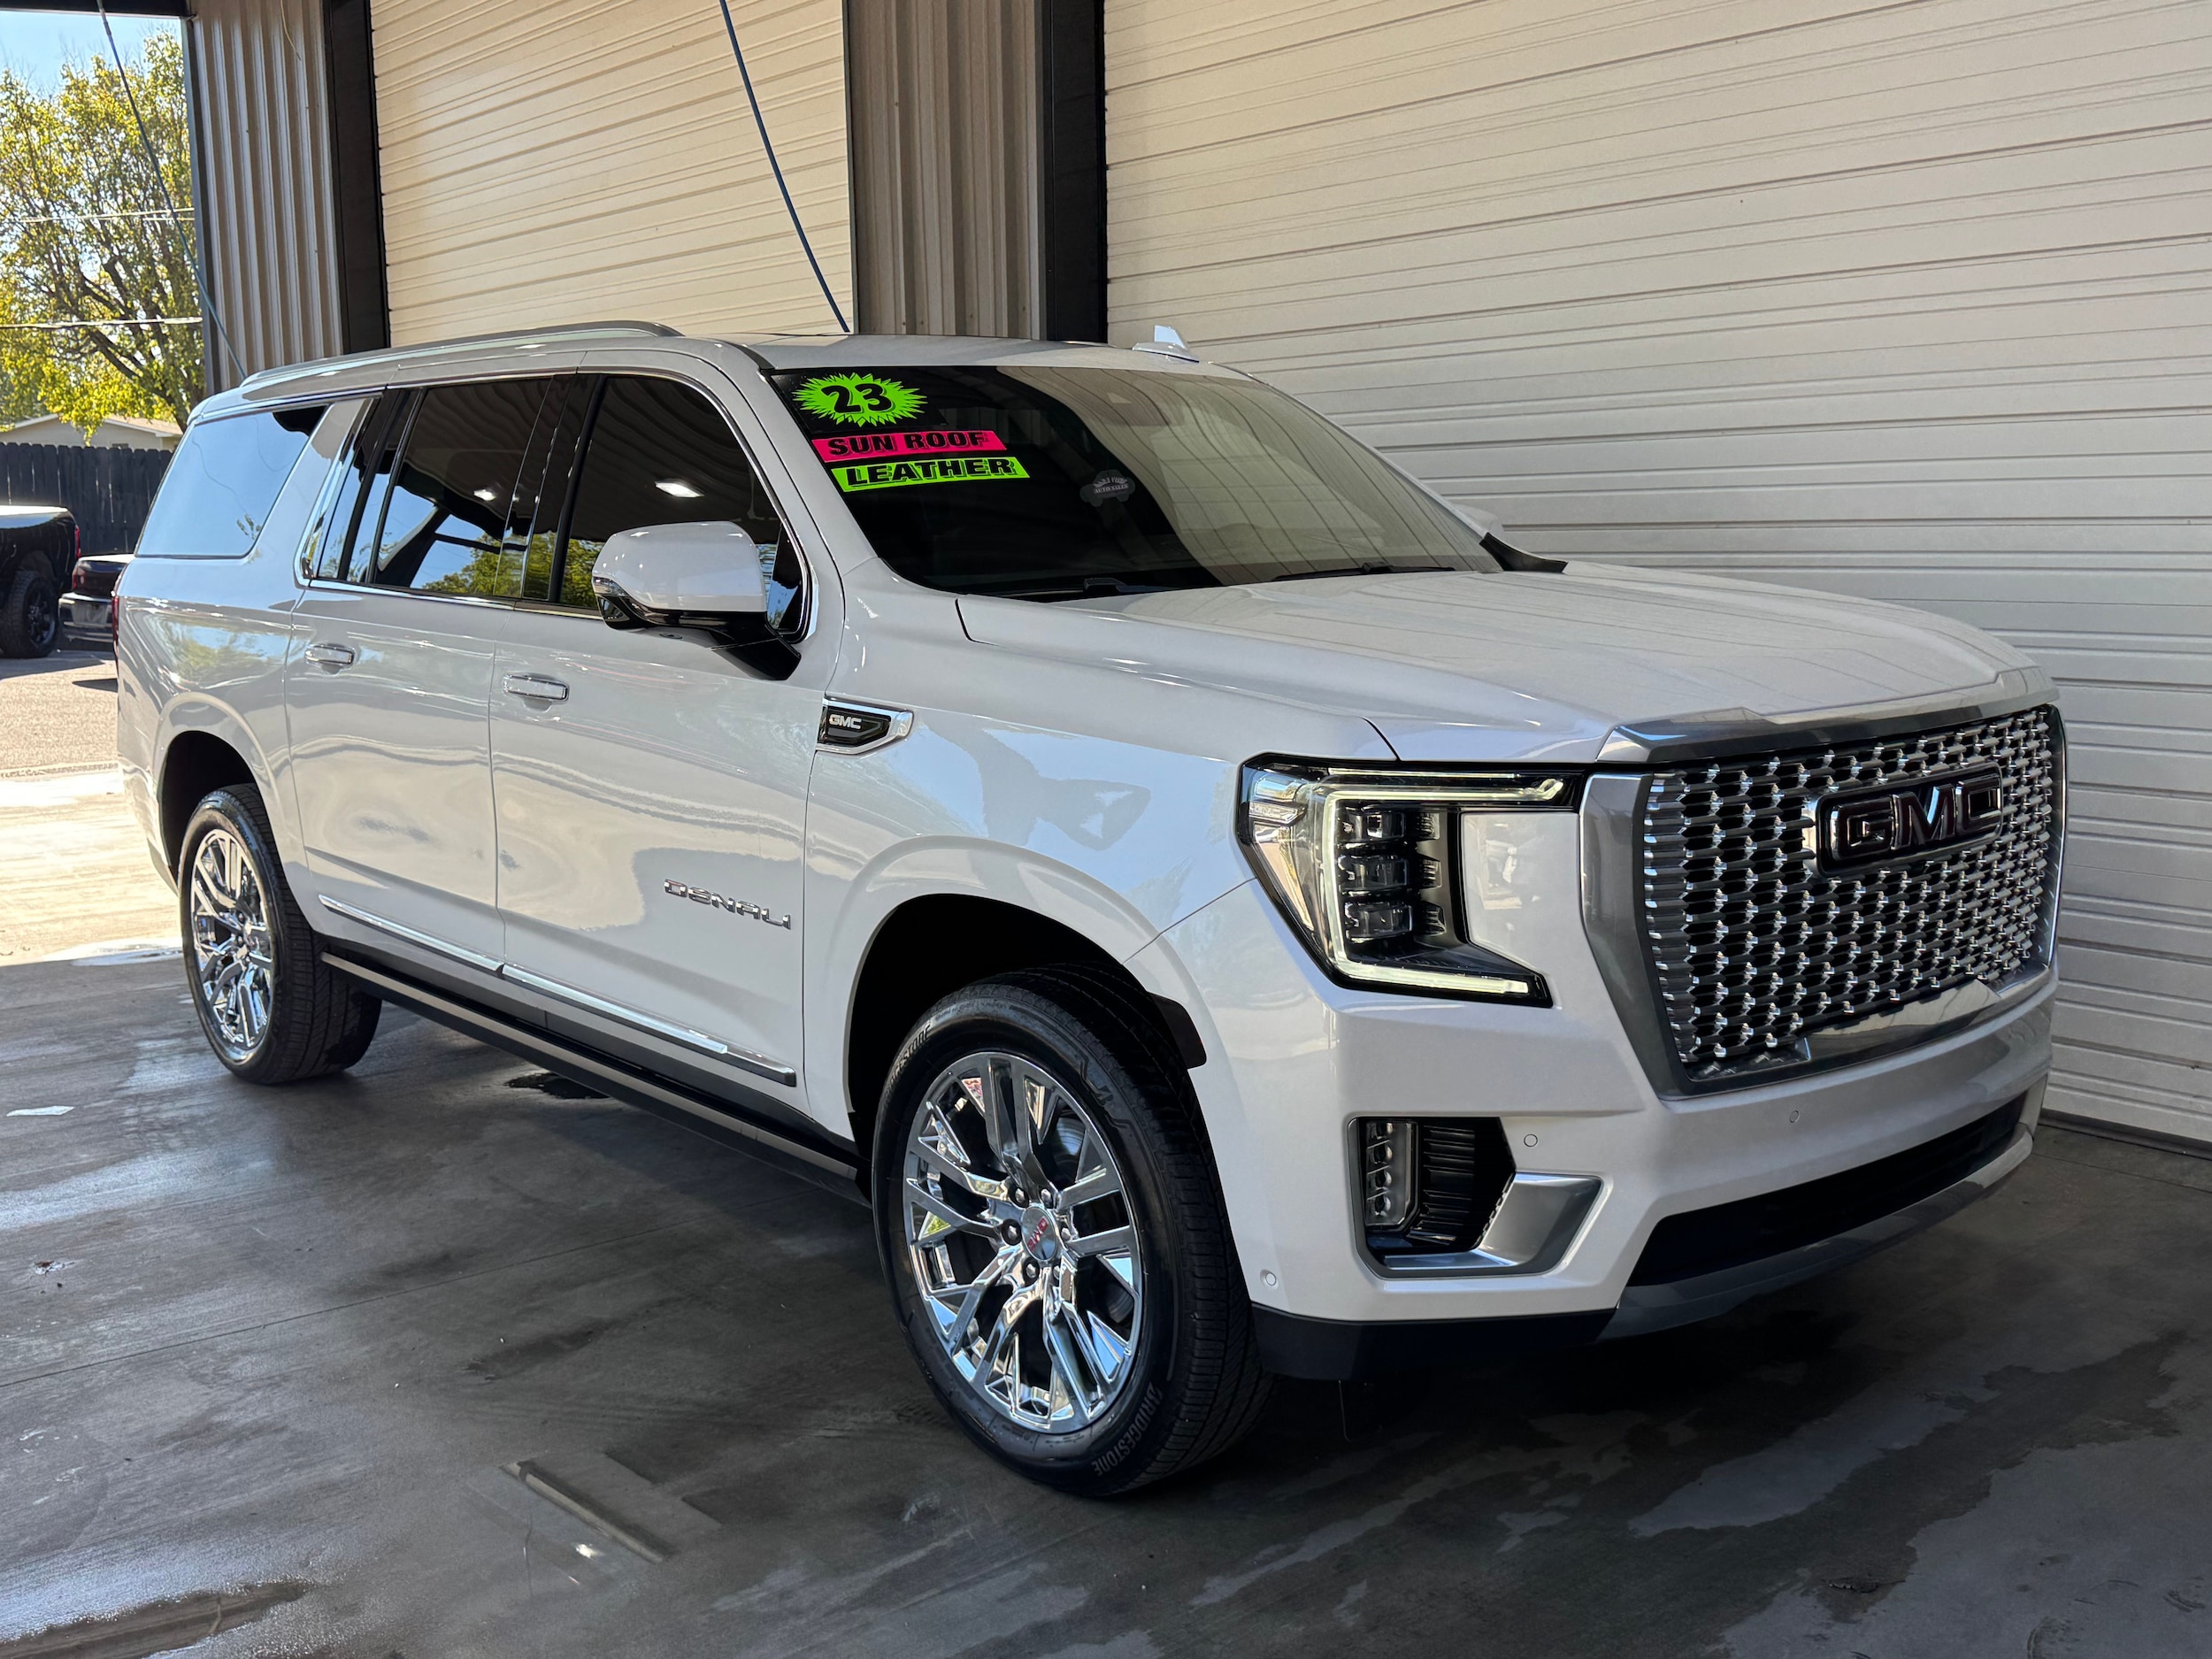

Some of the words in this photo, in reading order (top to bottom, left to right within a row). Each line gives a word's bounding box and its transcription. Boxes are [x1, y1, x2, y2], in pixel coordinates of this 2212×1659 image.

[821, 383, 895, 414] 23
[828, 434, 897, 457] SUN
[903, 431, 988, 450] ROOF
[846, 458, 1018, 487] LEATHER
[828, 713, 863, 730] GMC
[1830, 773, 2002, 861] GMC
[664, 878, 792, 930] DENALI
[1026, 1216, 1048, 1253] GMC
[1091, 1381, 1163, 1476] BRIDGESTONE
